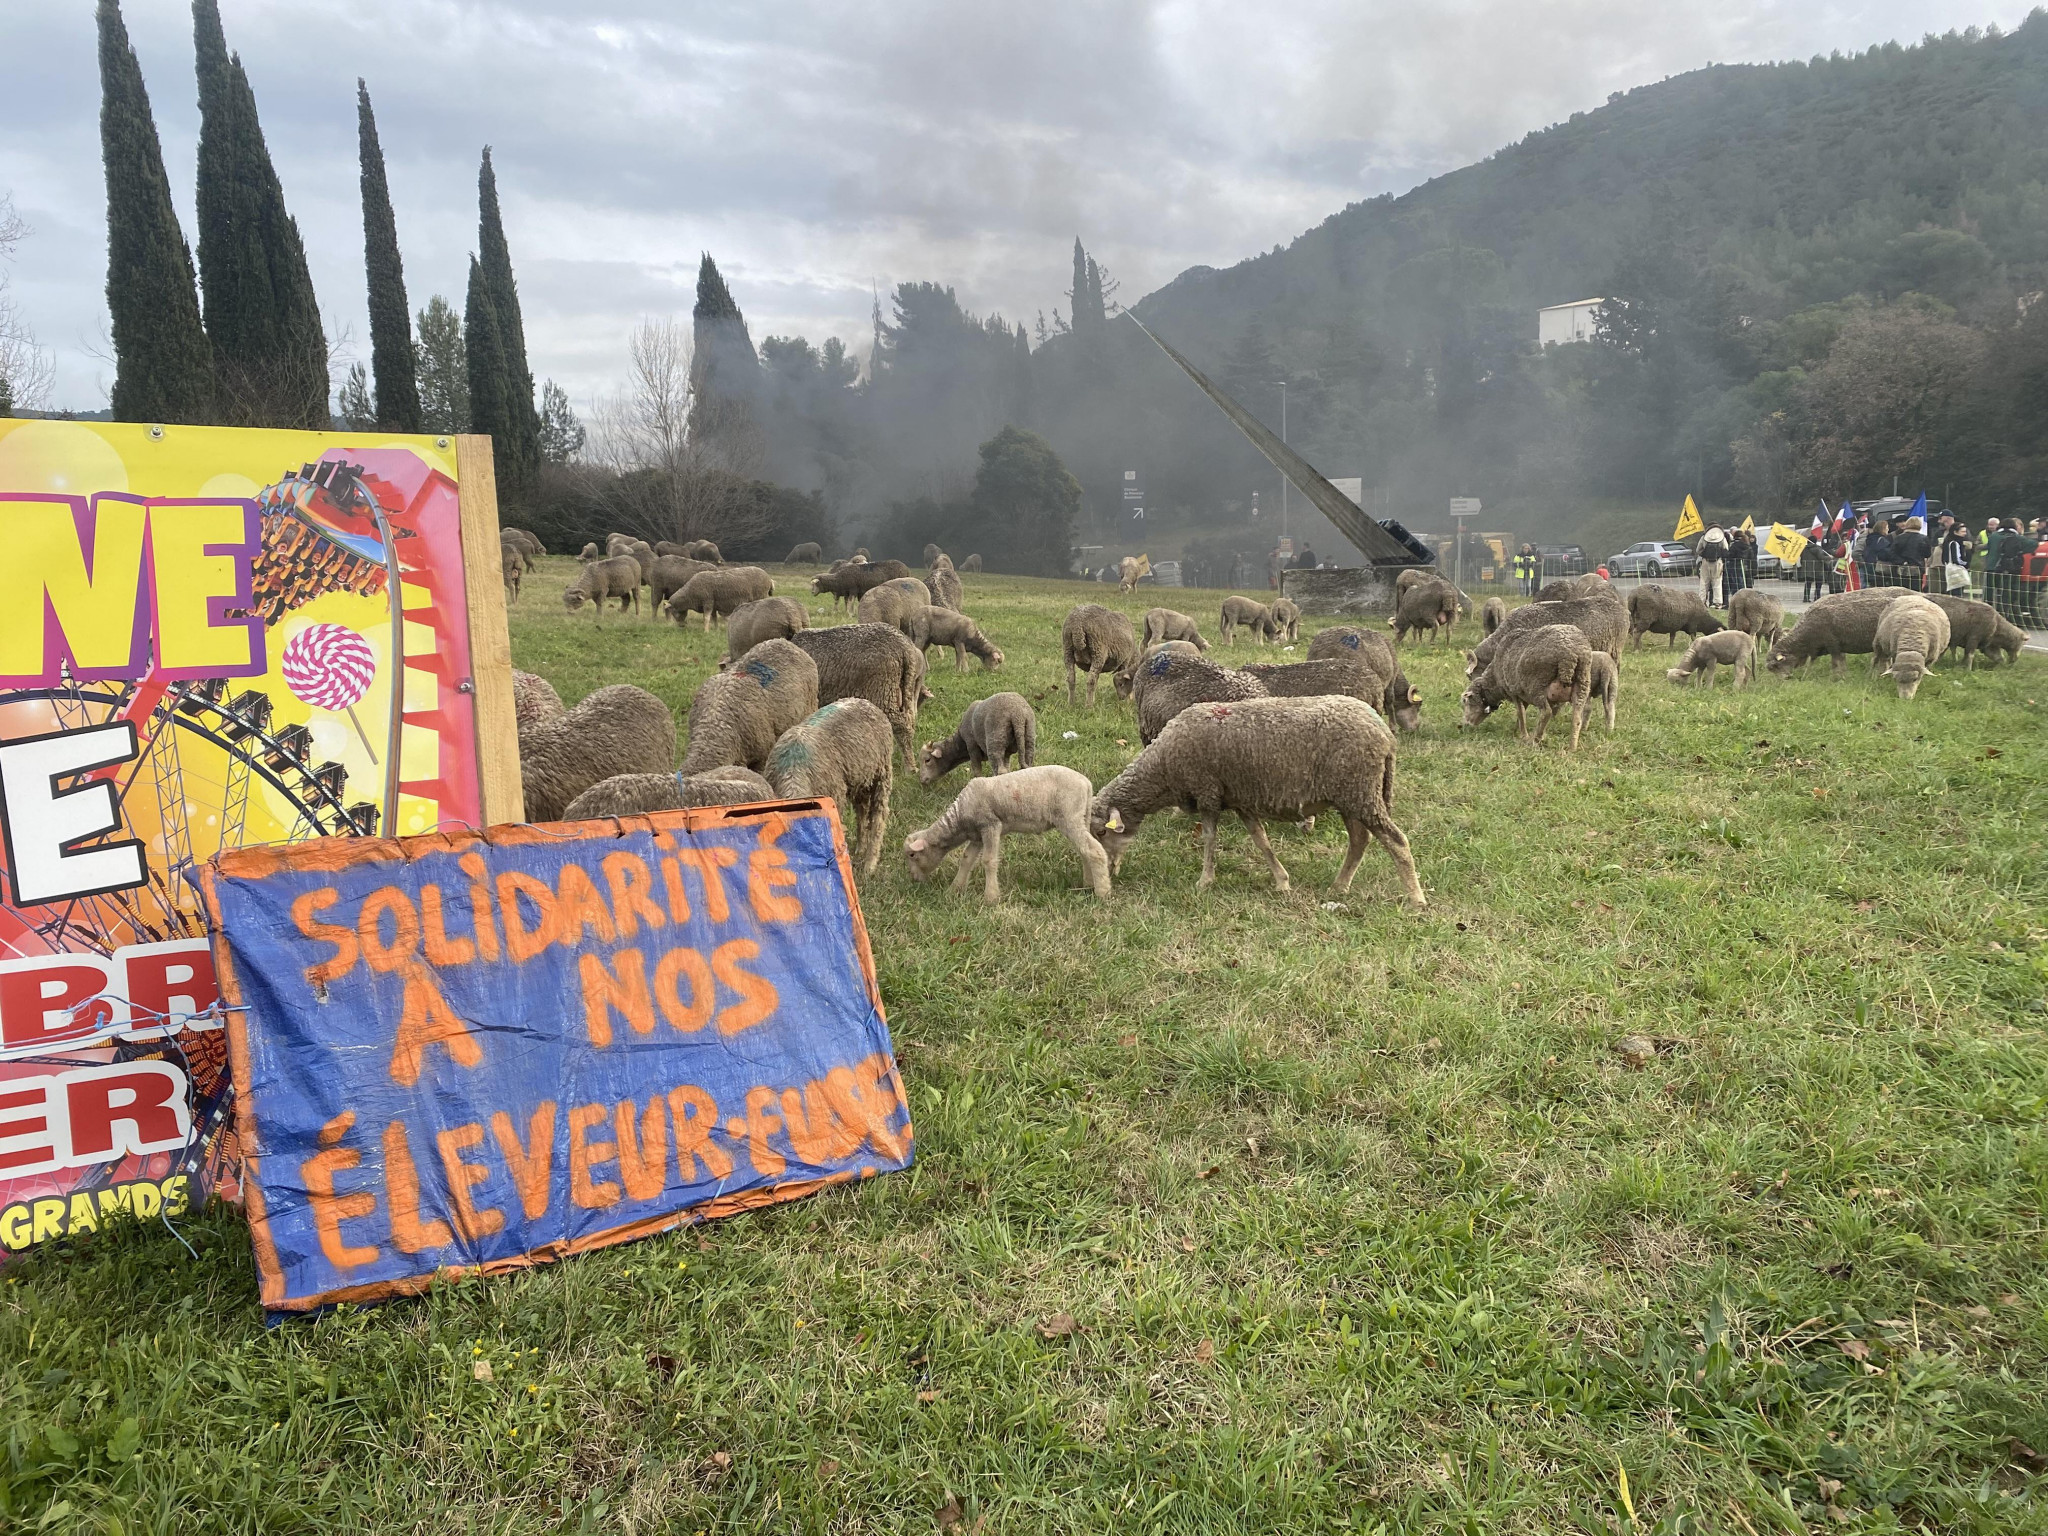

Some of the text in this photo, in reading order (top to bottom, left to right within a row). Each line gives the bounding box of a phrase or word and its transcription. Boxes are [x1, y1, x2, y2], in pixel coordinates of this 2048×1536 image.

[0, 493, 266, 687] NE
[0, 722, 148, 907] E
[577, 938, 780, 1048] NOS
[0, 1175, 189, 1250] GRANDS
